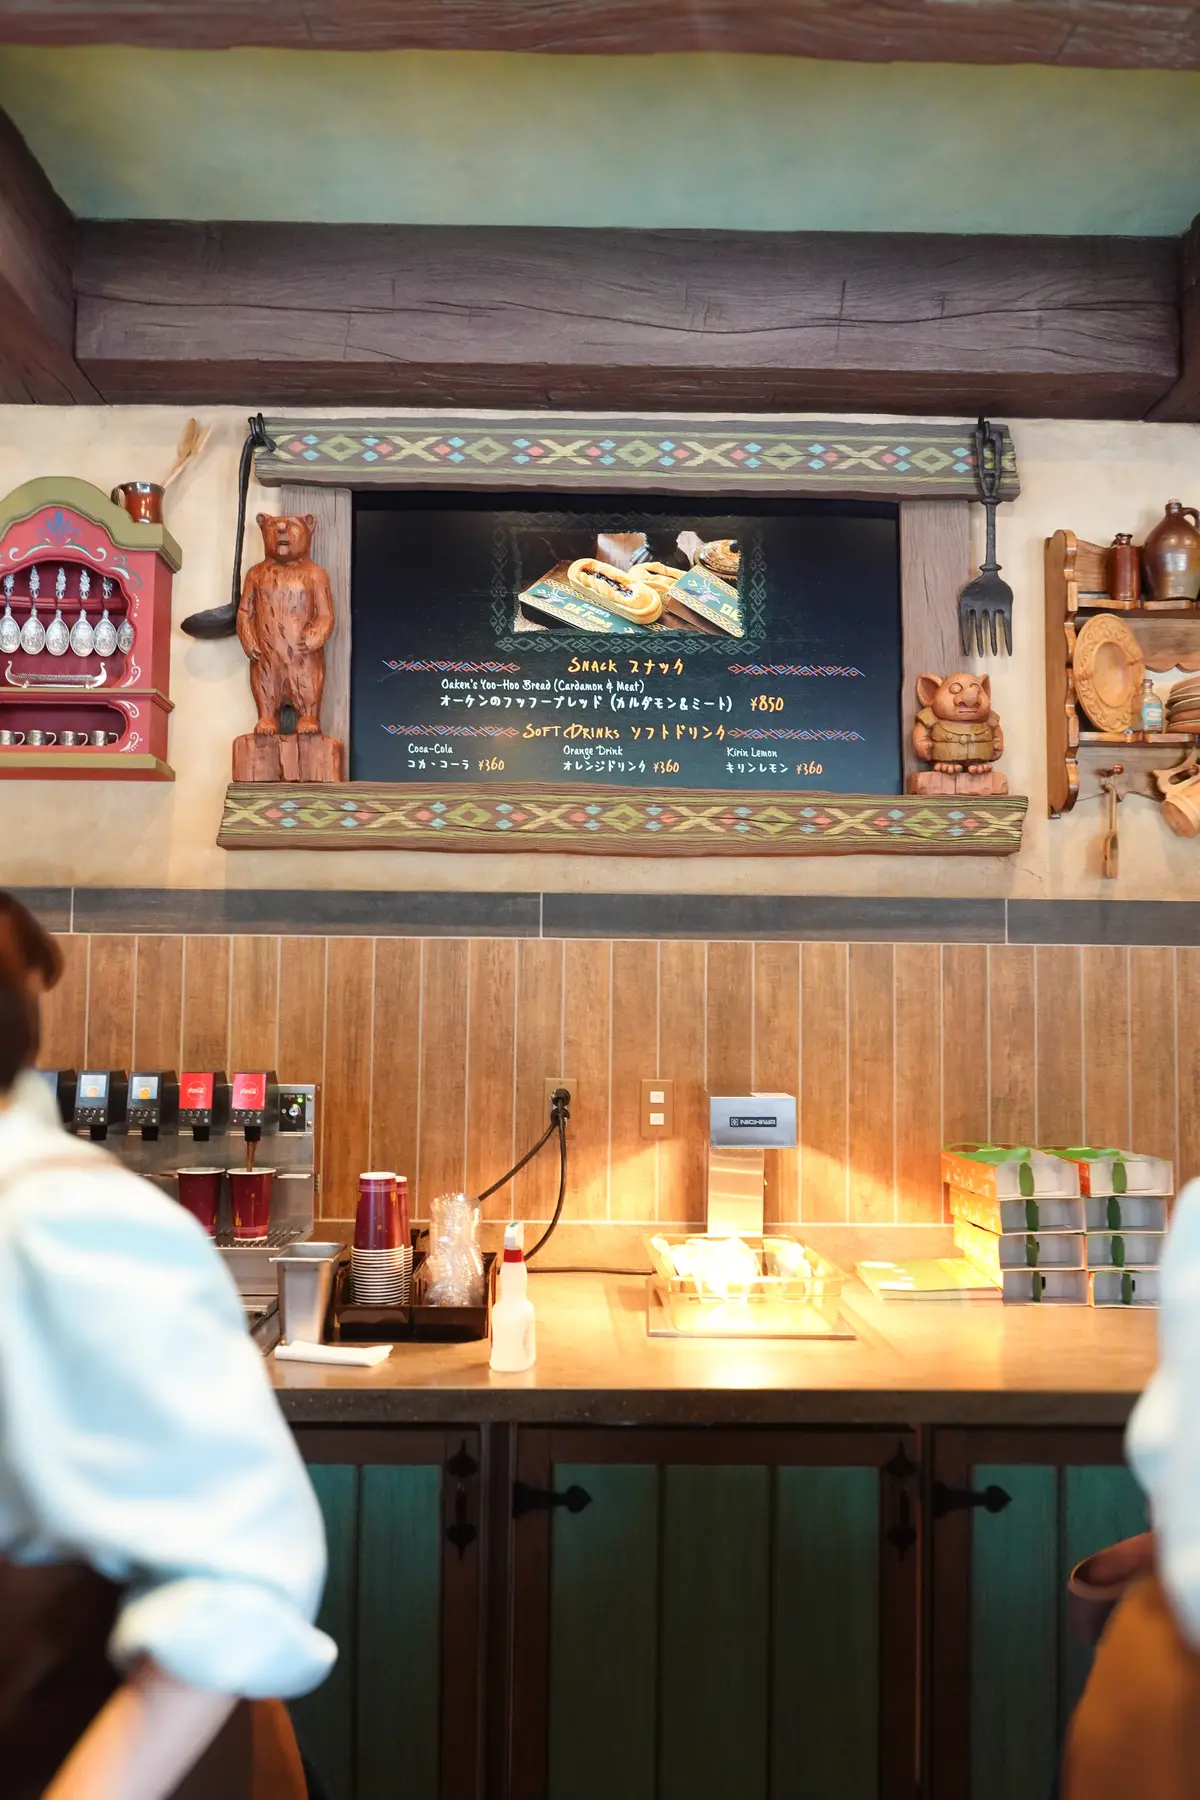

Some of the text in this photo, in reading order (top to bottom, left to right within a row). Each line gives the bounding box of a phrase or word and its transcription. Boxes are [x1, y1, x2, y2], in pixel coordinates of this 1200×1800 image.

[628, 657, 684, 676] スナック
[440, 678, 478, 690] Oaken's
[480, 678, 520, 691] Yoo-Hoo
[522, 679, 552, 691] Bread
[553, 678, 604, 693] (Cardamon
[615, 679, 645, 694] Meat)
[750, 694, 784, 713] ¥850
[630, 723, 725, 741] ソフトドリンク
[407, 742, 454, 754] Coca-Cola
[563, 744, 623, 760] Orange Drink
[726, 746, 778, 758] Kirin Lemon
[407, 756, 505, 772] コカ・コーラ ¥360
[562, 758, 680, 774] オレンジドリンク ¥360
[725, 760, 823, 775] キリンレモン ¥360
